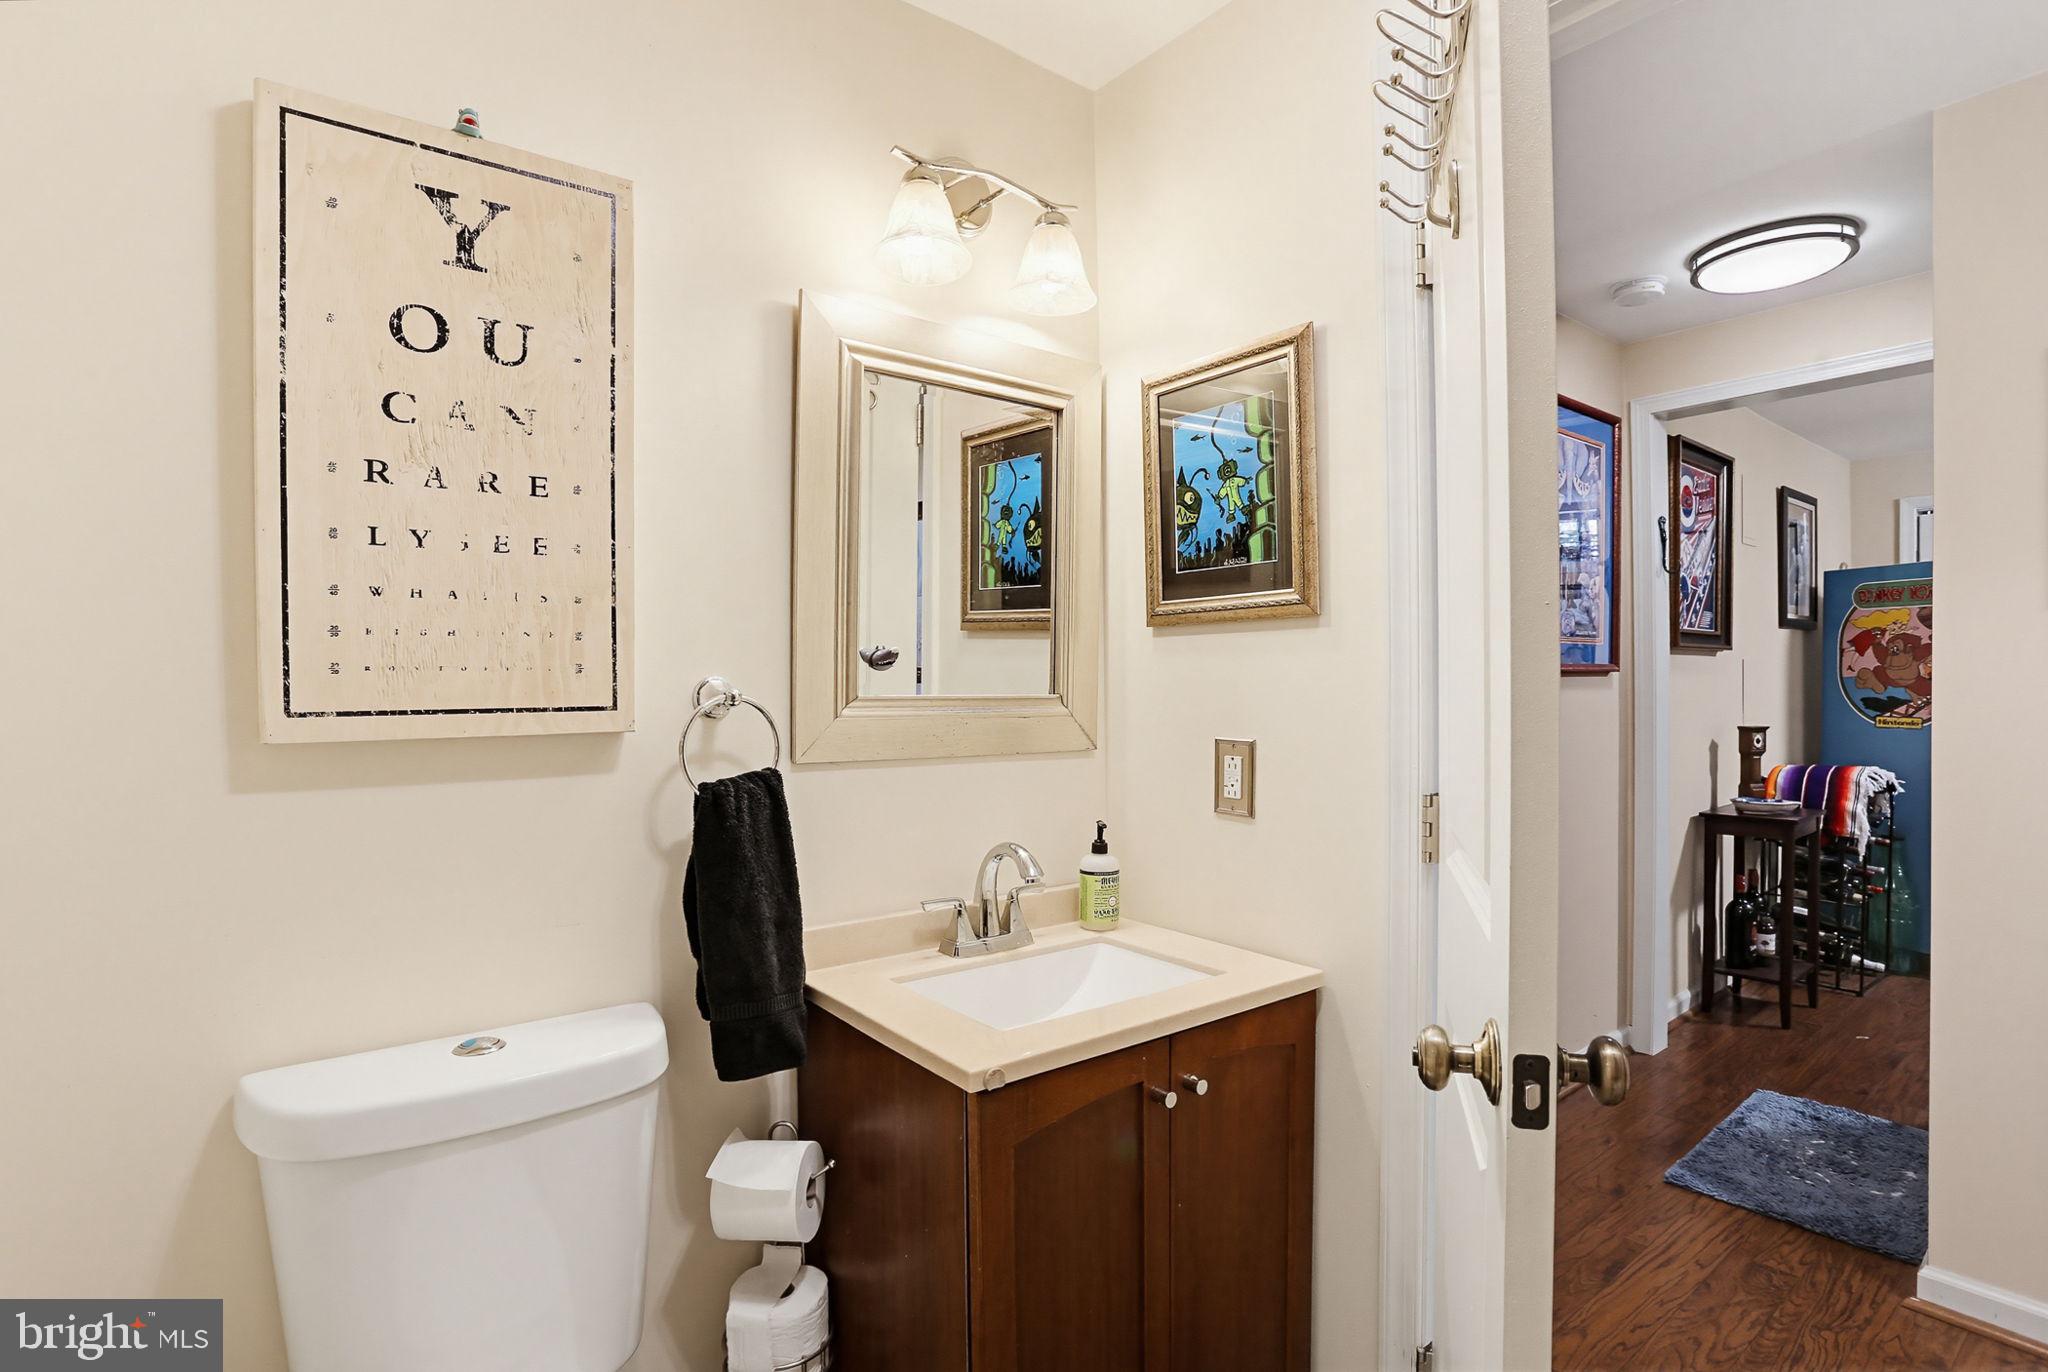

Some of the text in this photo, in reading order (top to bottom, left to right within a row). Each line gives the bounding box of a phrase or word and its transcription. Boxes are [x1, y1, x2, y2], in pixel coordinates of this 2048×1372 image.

[414, 183, 511, 274] Y
[388, 304, 534, 367] OU
[363, 458, 549, 498] RARE
[1858, 587, 1904, 603] DNKEY
